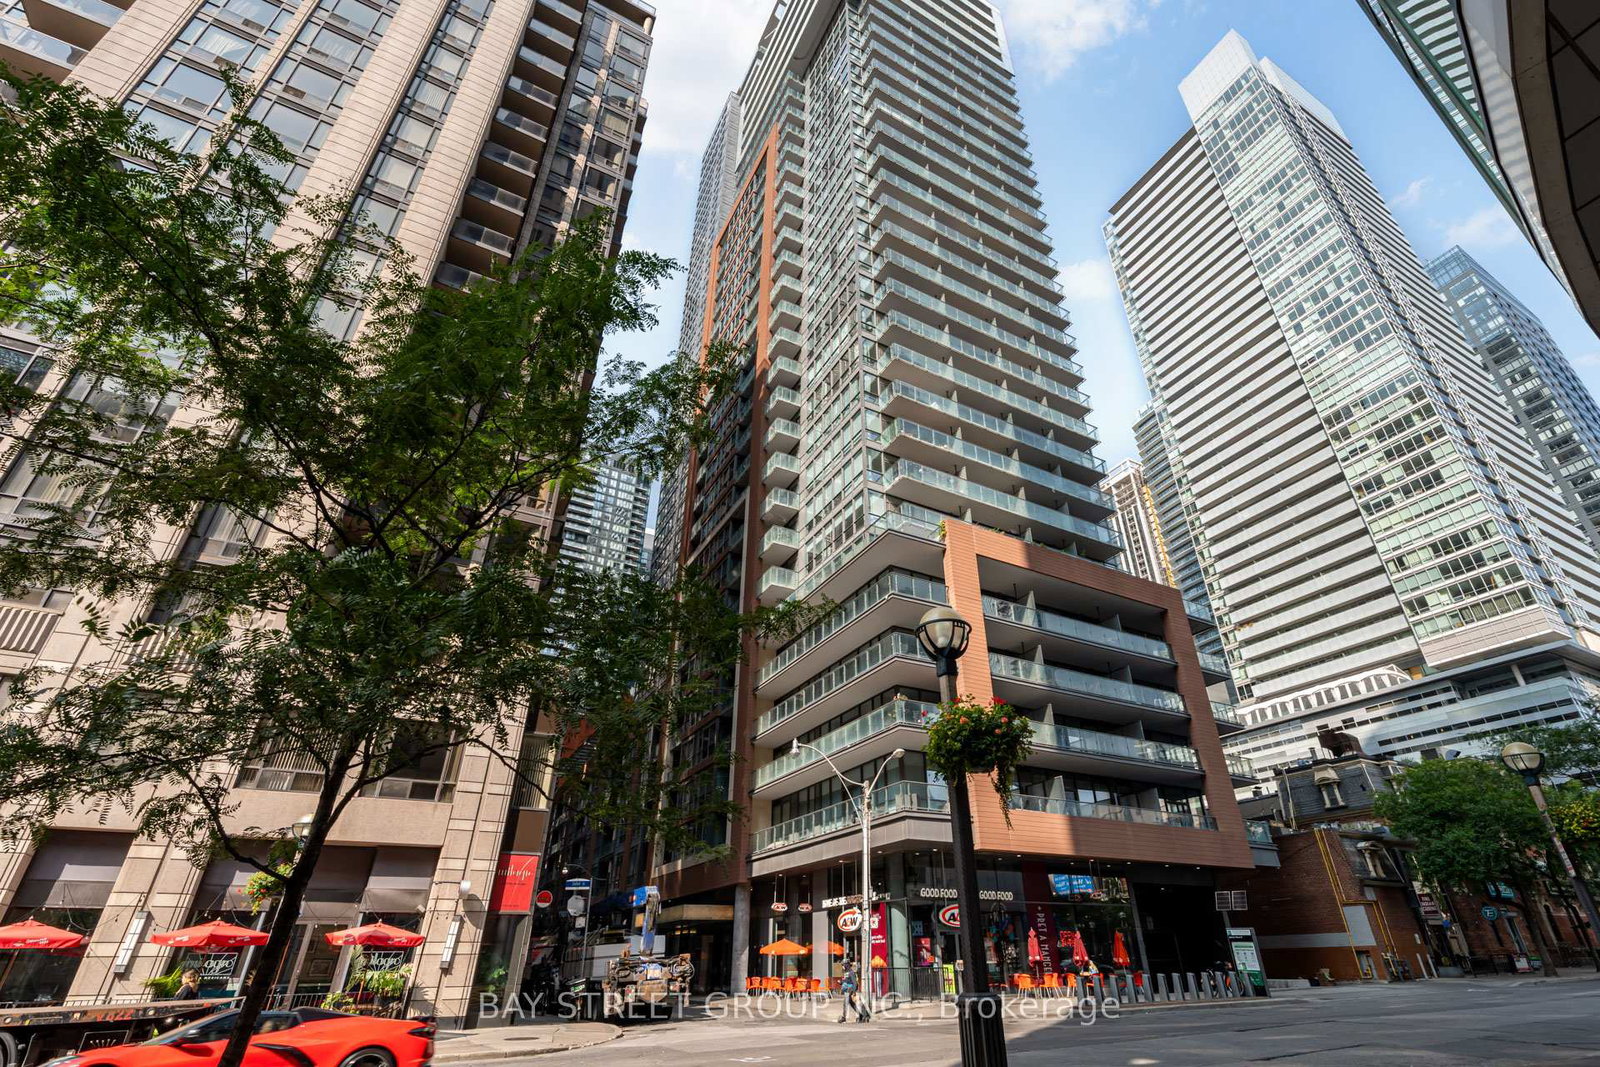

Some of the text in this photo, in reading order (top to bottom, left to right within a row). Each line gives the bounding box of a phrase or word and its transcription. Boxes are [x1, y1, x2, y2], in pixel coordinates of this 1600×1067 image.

[919, 887, 958, 898] GOOD FOOD
[979, 890, 1014, 901] GOOD FOOD
[841, 916, 859, 926] A&W
